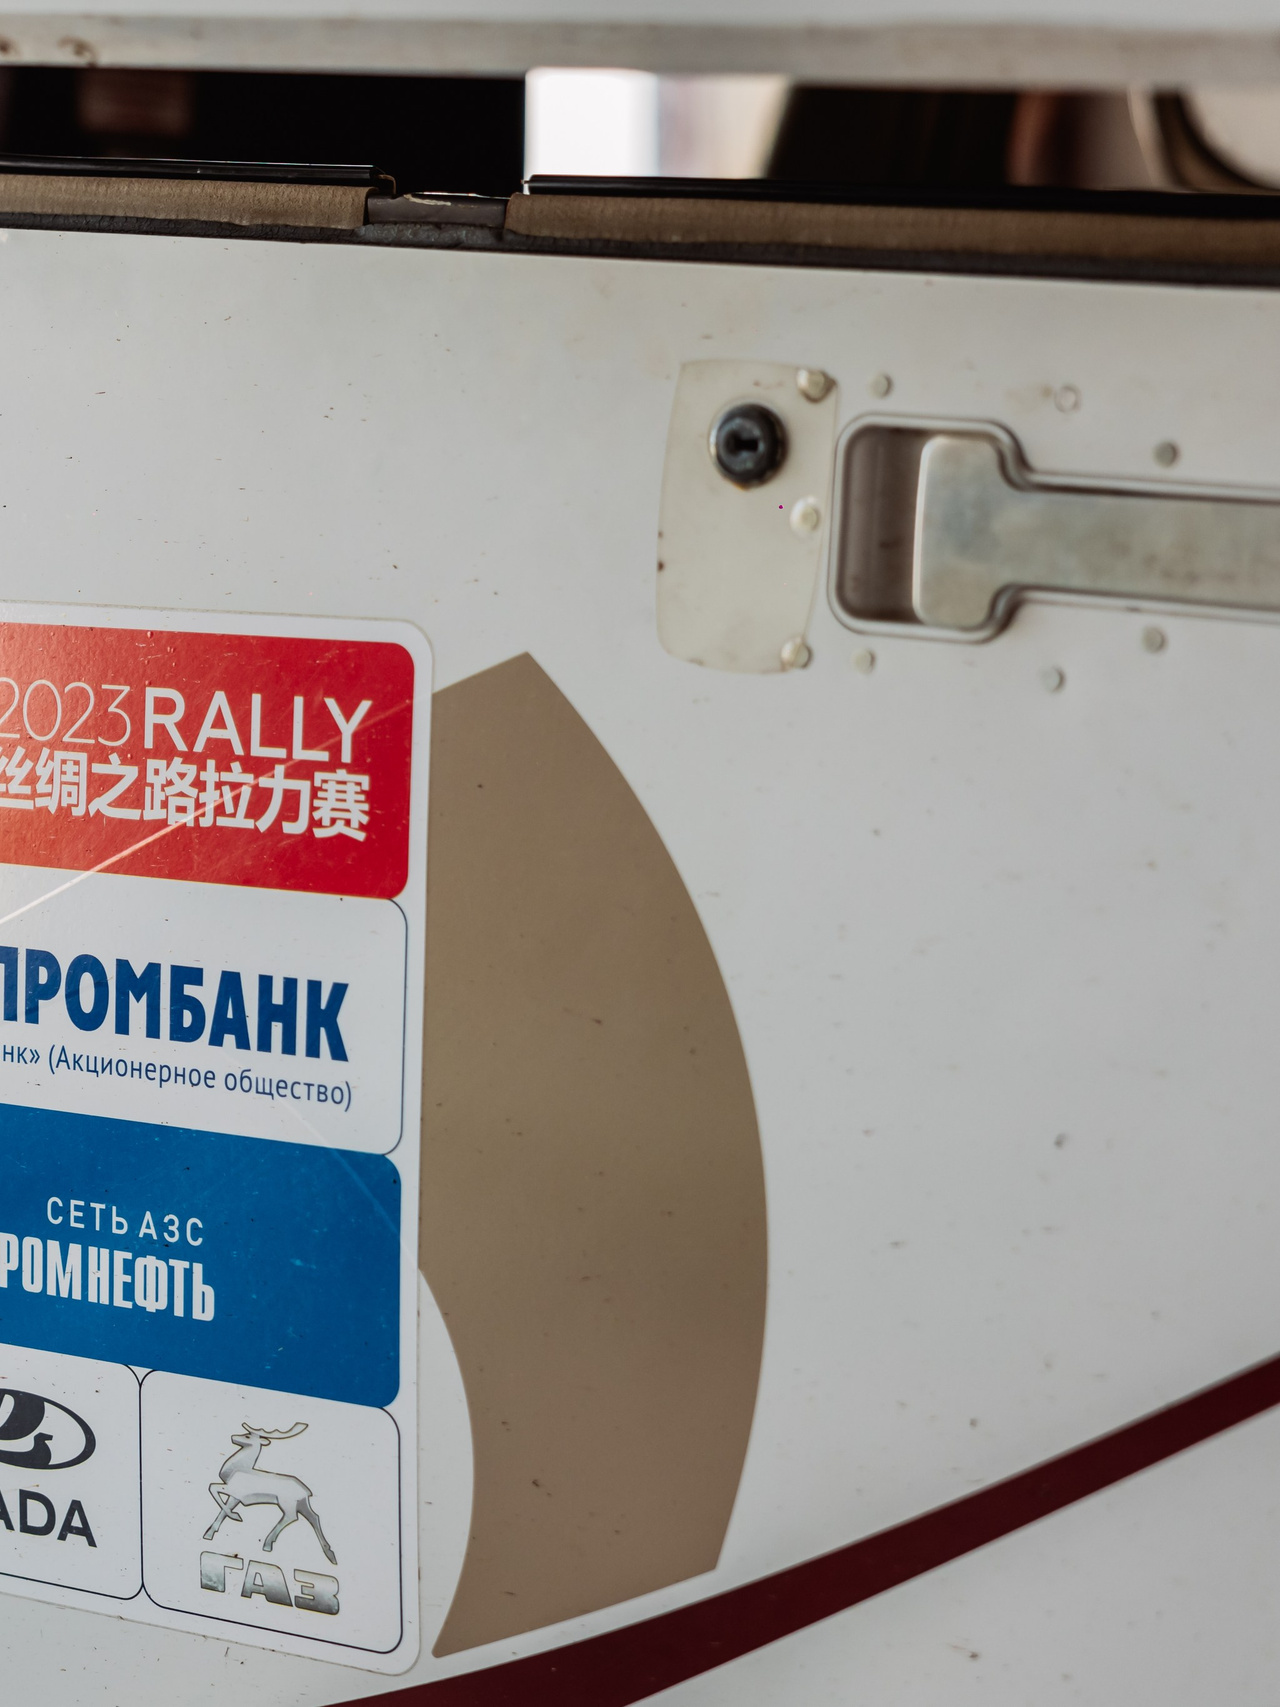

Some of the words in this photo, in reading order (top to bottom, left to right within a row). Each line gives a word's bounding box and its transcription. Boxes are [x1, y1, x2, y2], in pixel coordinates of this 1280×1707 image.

[144, 686, 373, 763] RALLY
[47, 1052, 216, 1090] (Акционерное
[223, 1070, 353, 1112] общество)
[46, 1196, 129, 1235] СЕТЬ
[138, 1210, 204, 1246] АЗС
[199, 1550, 340, 1615] ГАЗ
